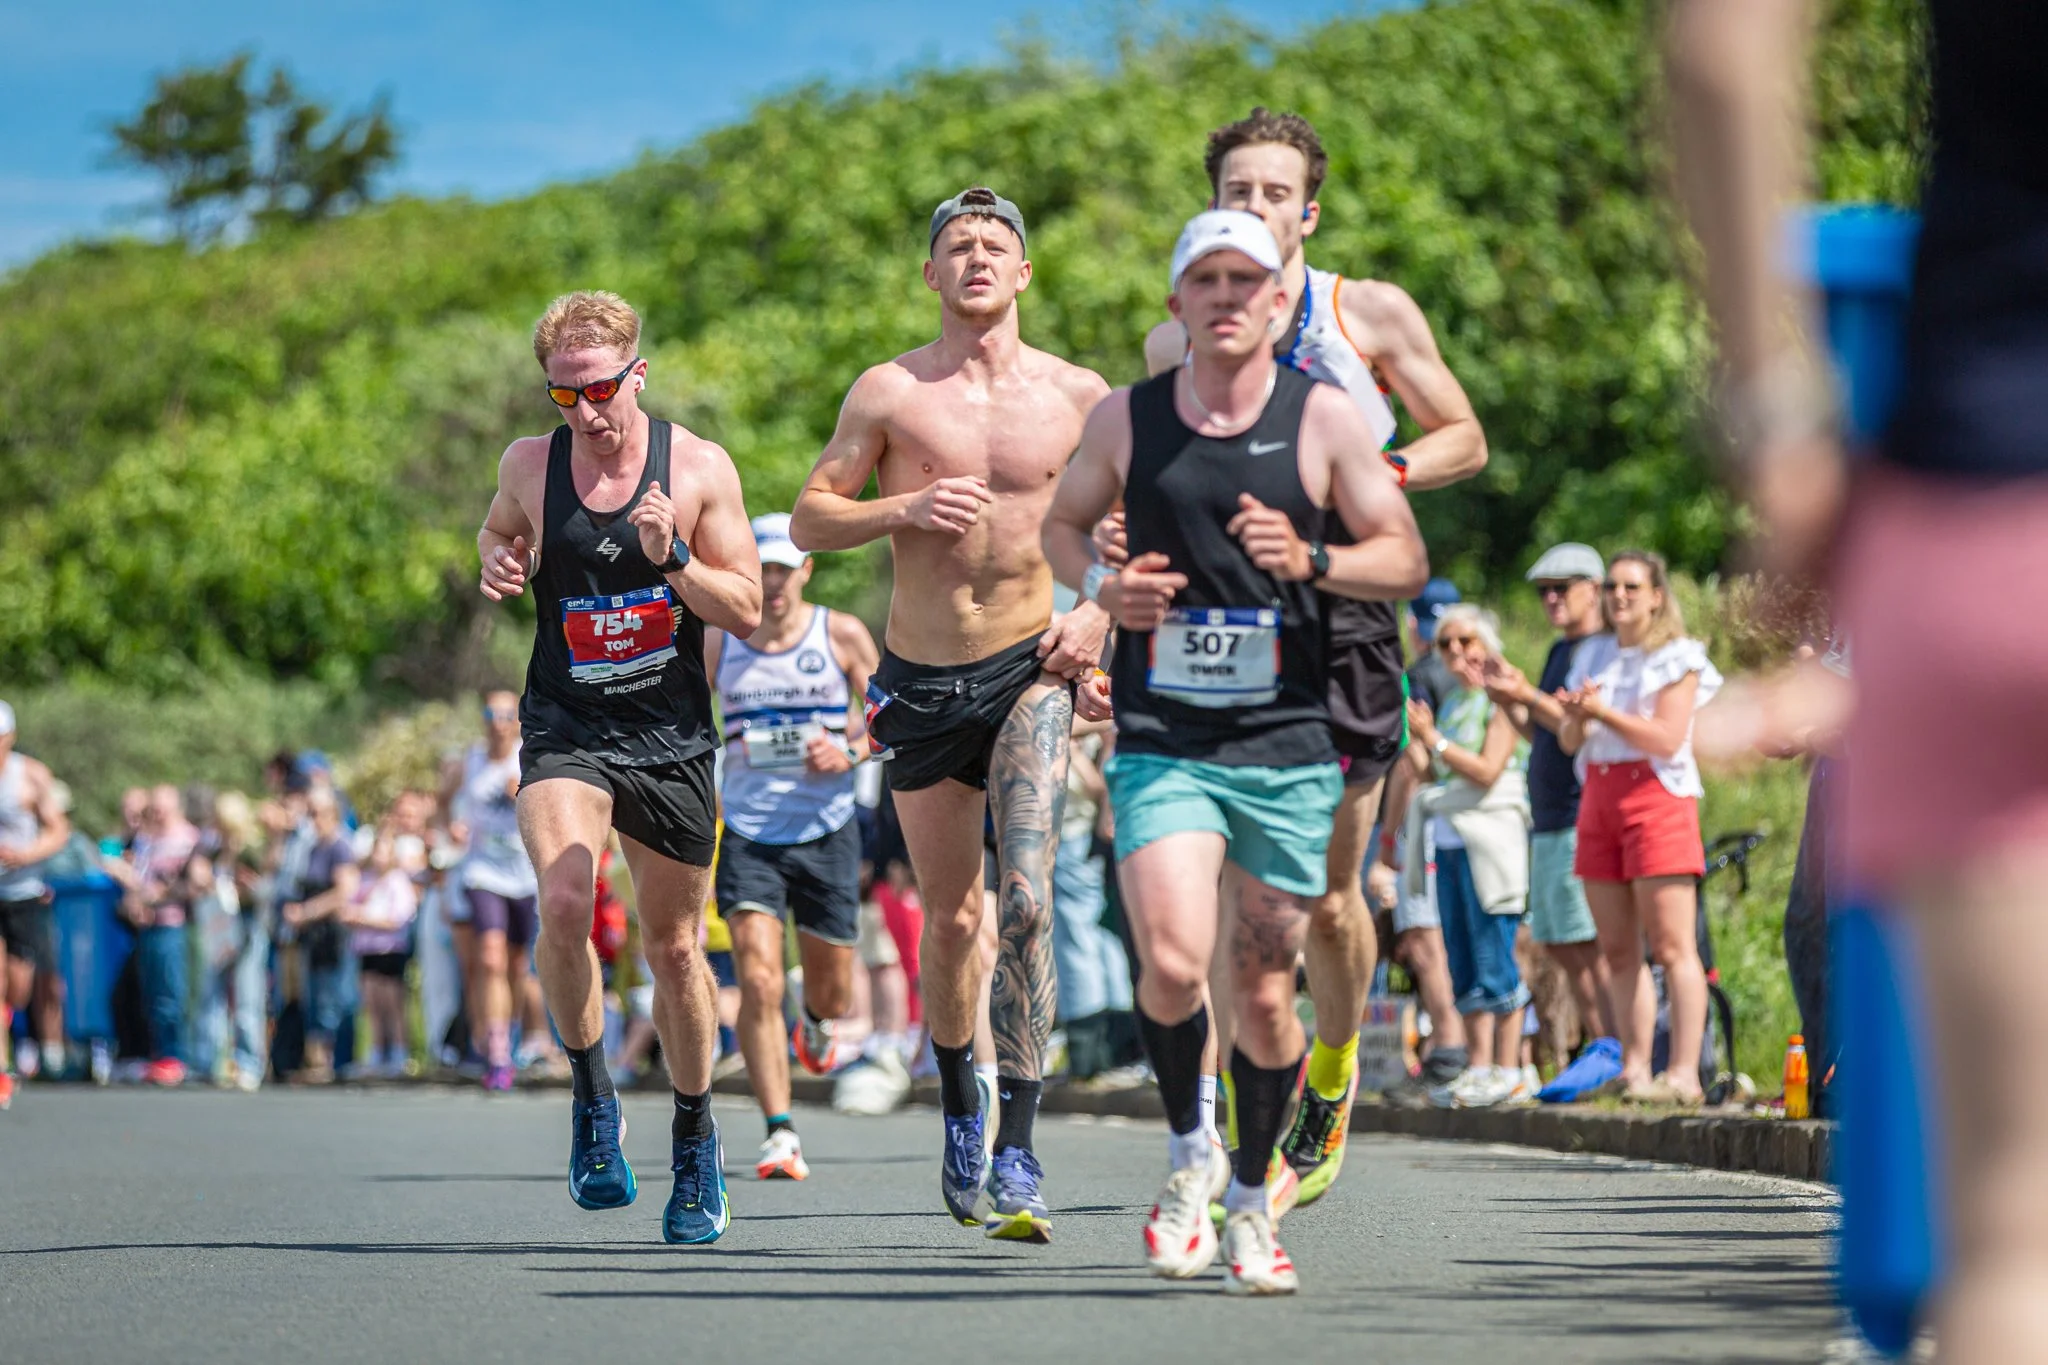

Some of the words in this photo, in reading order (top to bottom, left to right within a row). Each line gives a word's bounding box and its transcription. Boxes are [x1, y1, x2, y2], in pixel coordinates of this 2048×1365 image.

[590, 610, 644, 636] 754
[604, 637, 635, 652] TOM
[1183, 631, 1242, 657] 507
[604, 675, 662, 695] MANCHESTER
